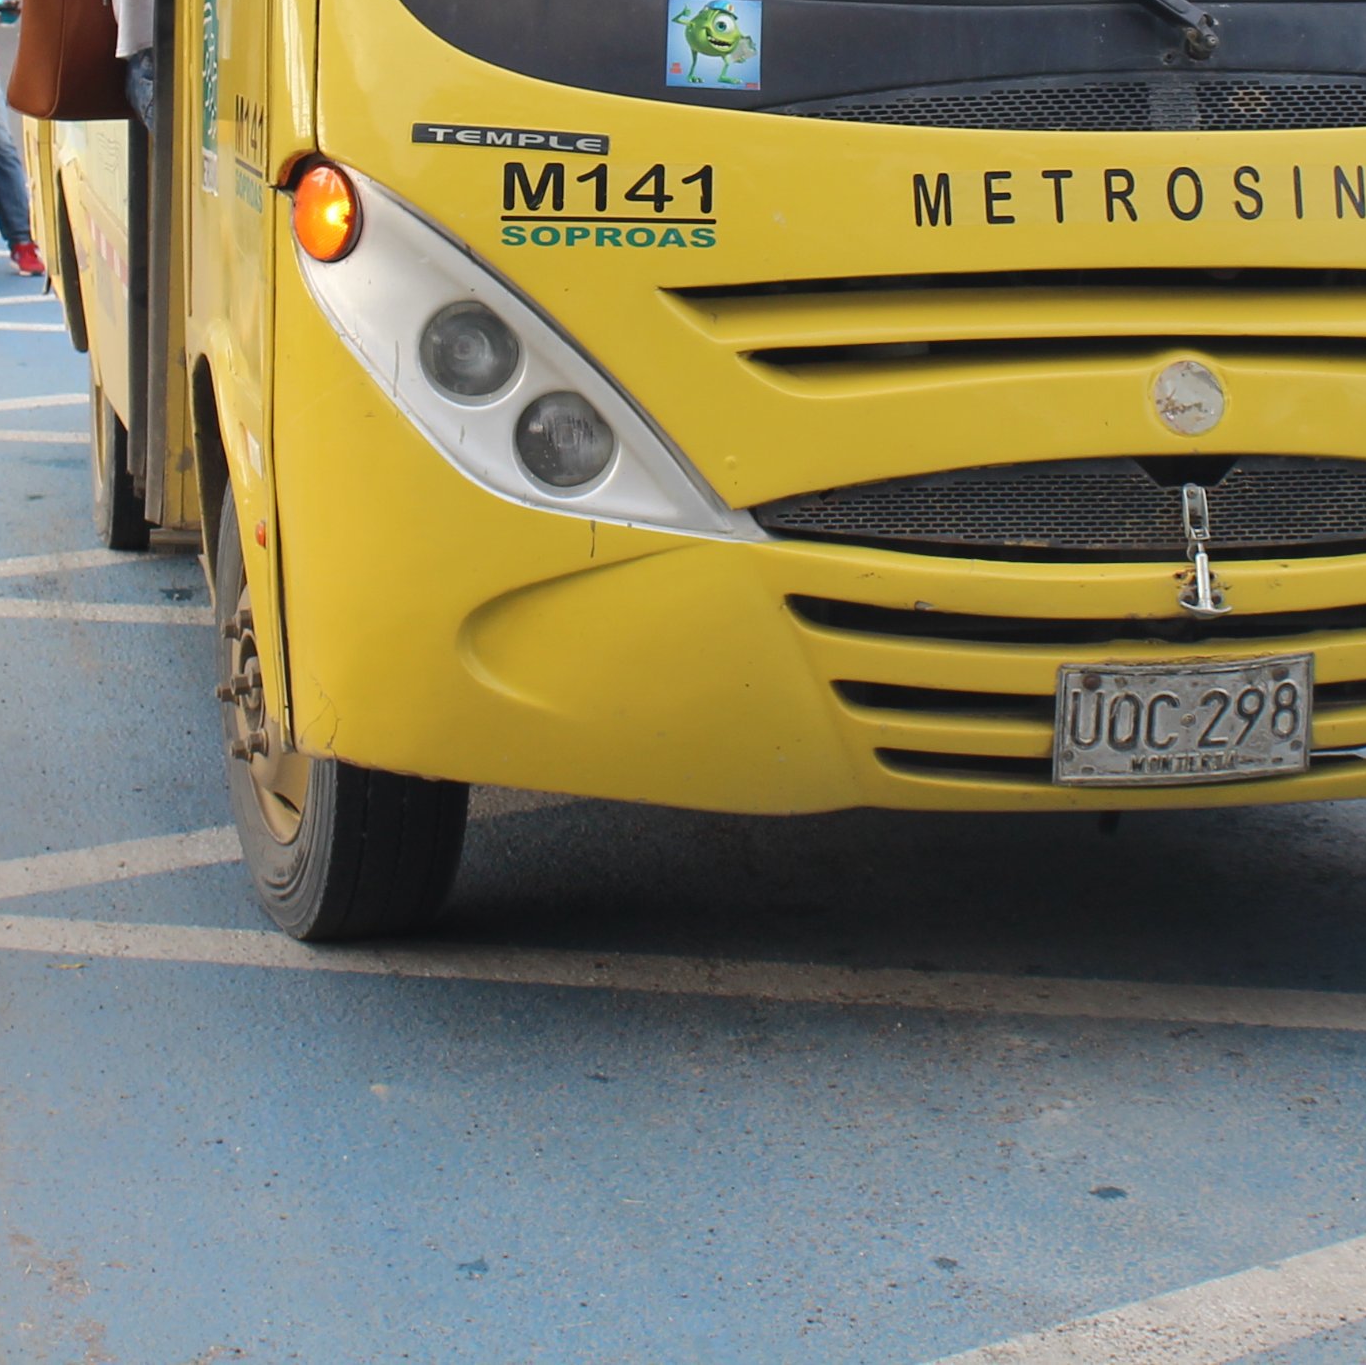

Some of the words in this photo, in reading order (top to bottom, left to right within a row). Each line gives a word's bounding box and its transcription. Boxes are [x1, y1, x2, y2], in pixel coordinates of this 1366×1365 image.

[428, 127, 602, 152] TEMPLE
[503, 162, 714, 214] M141
[501, 226, 716, 248] SOPROAS
[1199, 680, 1297, 745] 298
